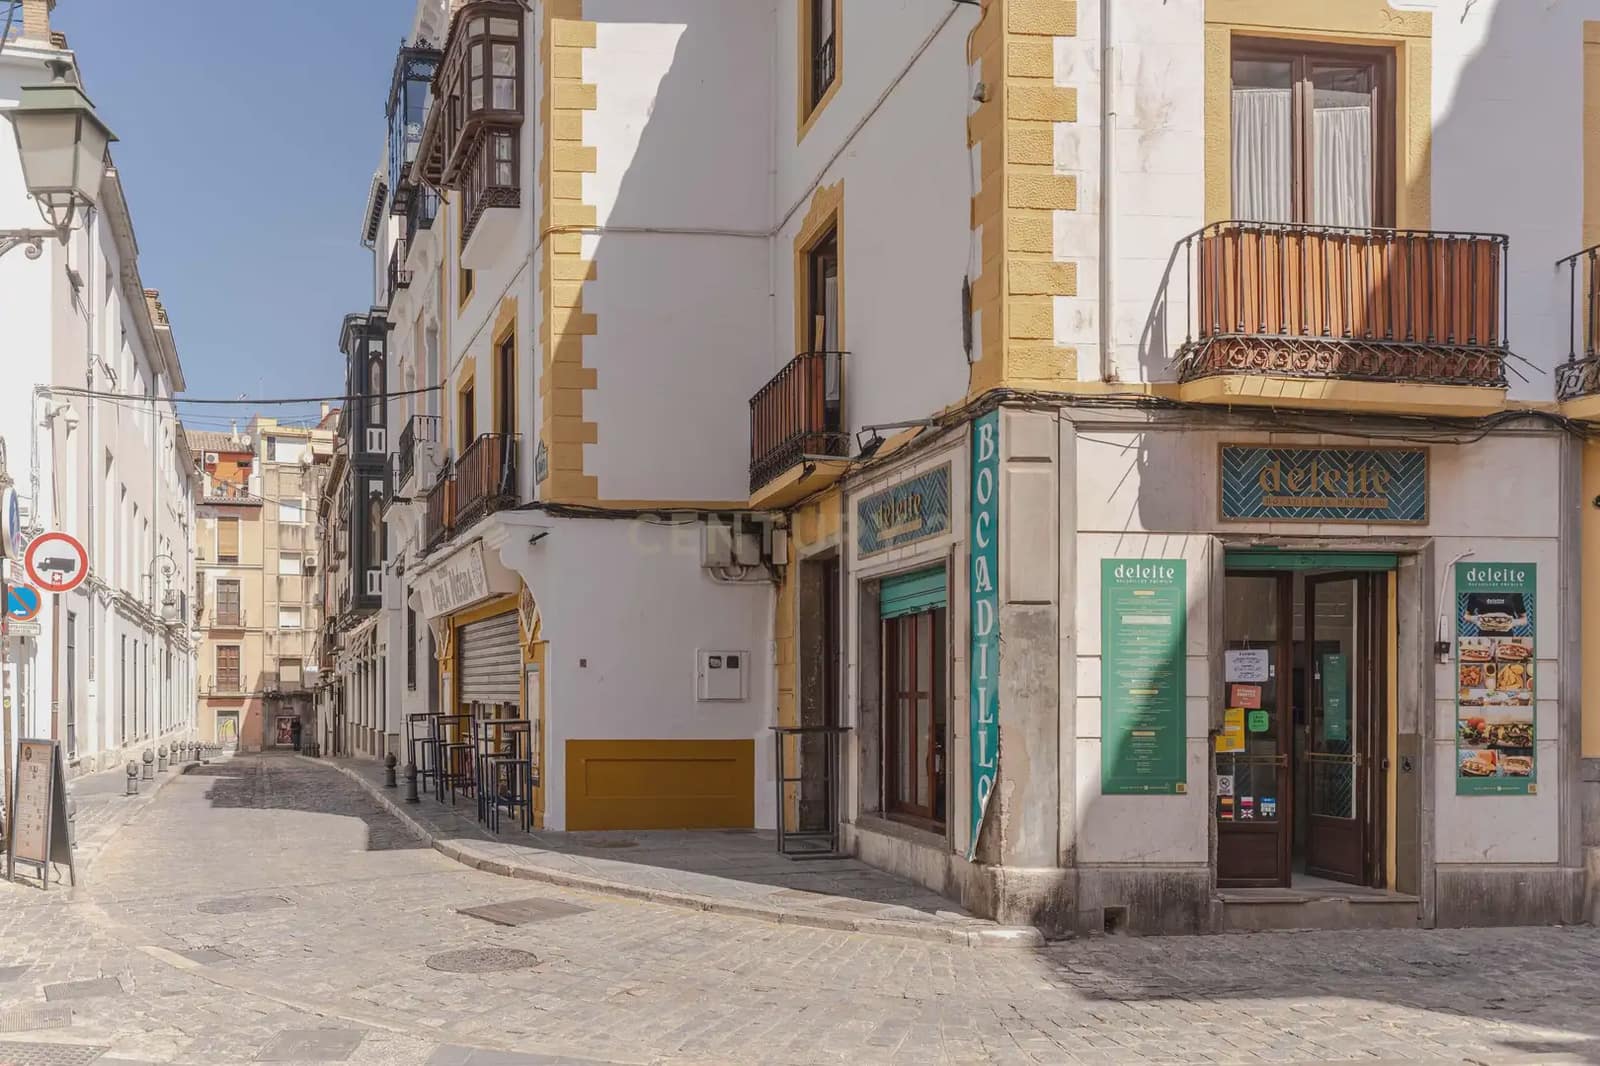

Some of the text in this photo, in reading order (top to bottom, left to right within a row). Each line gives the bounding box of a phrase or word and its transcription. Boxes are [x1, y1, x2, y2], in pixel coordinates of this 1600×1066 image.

[1258, 459, 1391, 494] deleite
[1114, 563, 1175, 579] deleite
[1466, 567, 1526, 582] deleite
